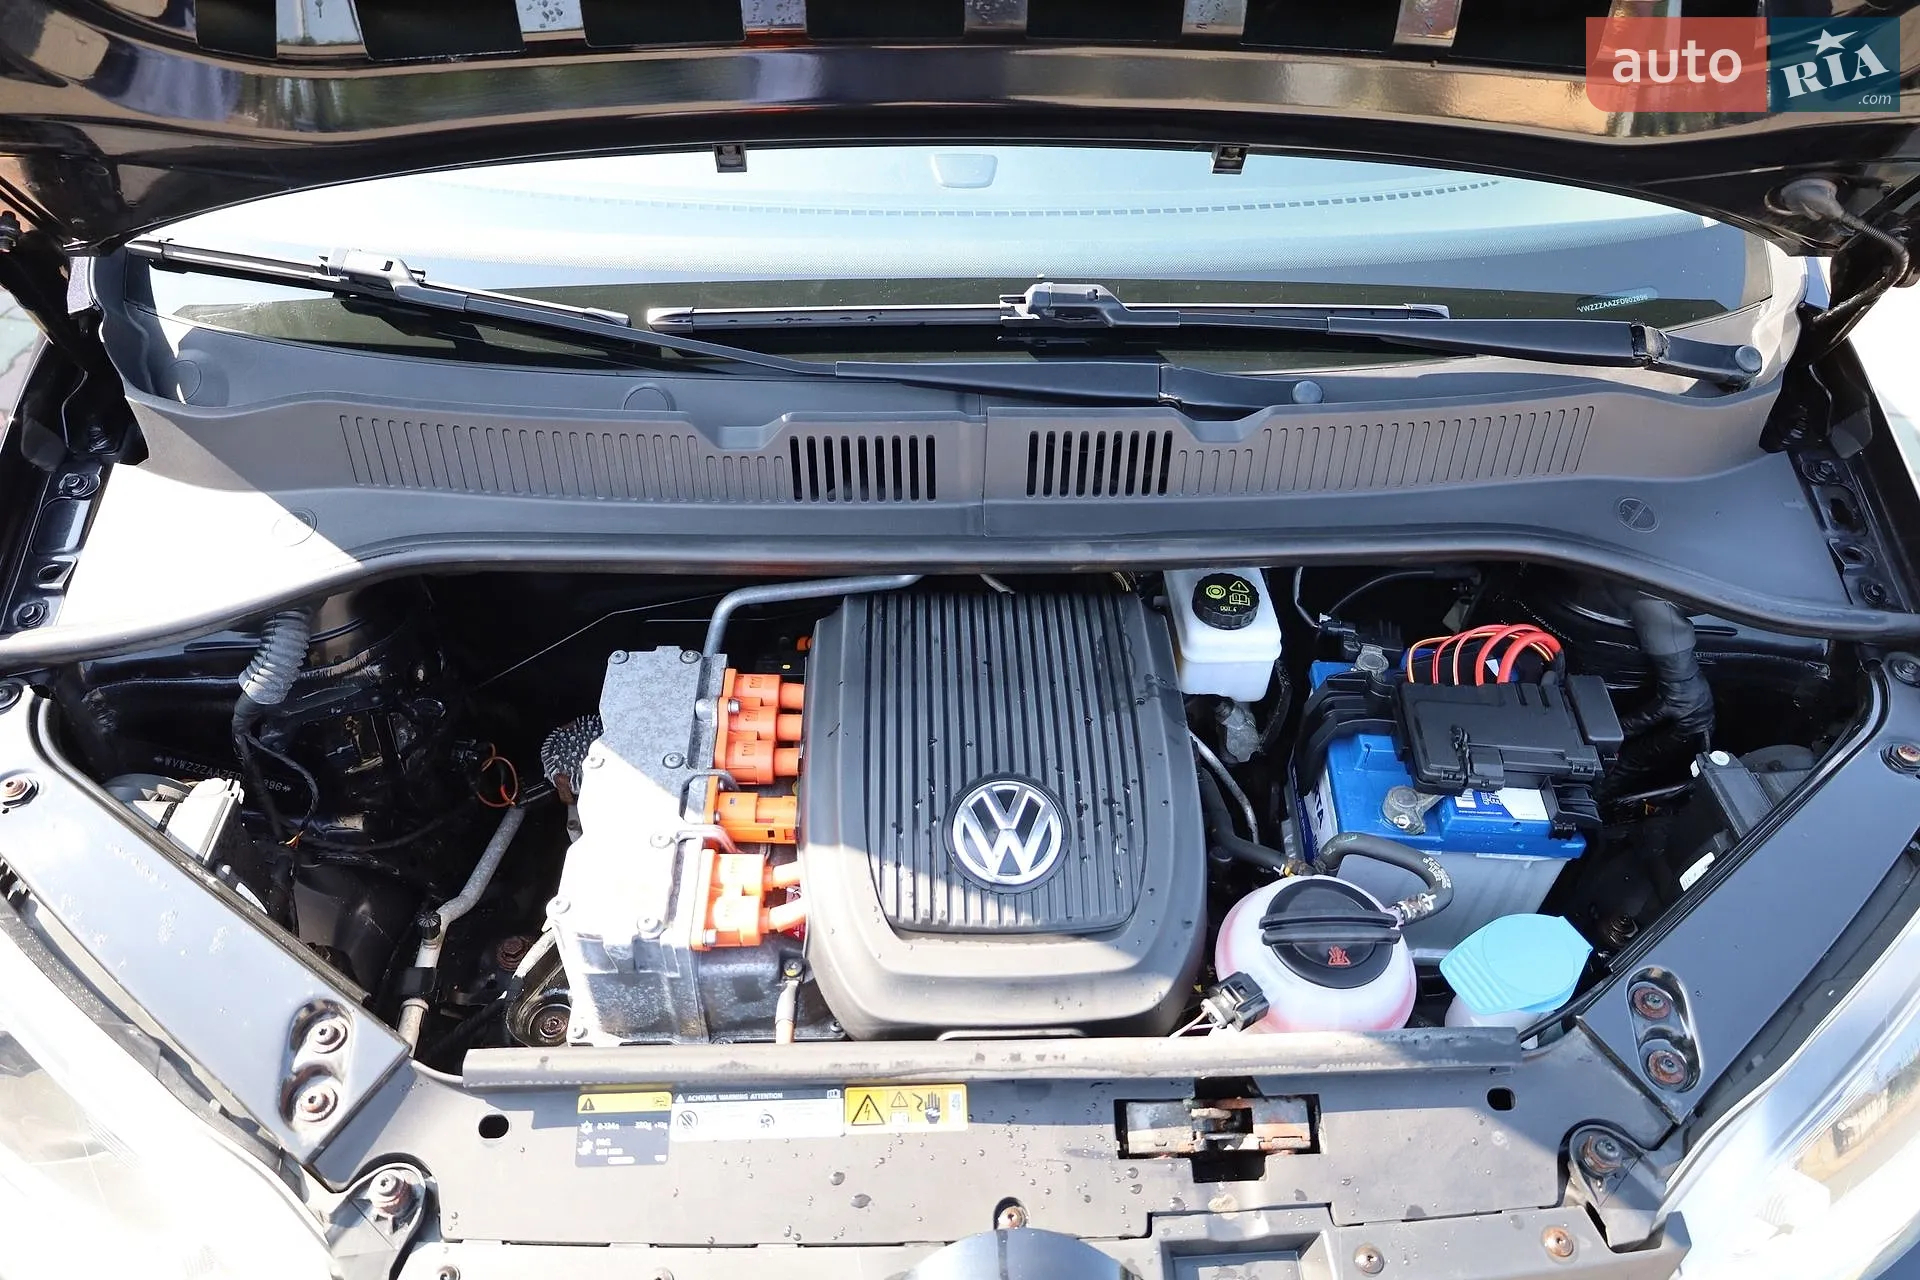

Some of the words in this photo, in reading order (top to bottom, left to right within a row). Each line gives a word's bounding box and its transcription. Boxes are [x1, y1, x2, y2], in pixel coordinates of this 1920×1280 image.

[953, 781, 1062, 885] VW
[687, 1094, 717, 1102] ACHTUNG
[718, 1093, 749, 1101] WARNING
[750, 1092, 783, 1100] ATTENTION
